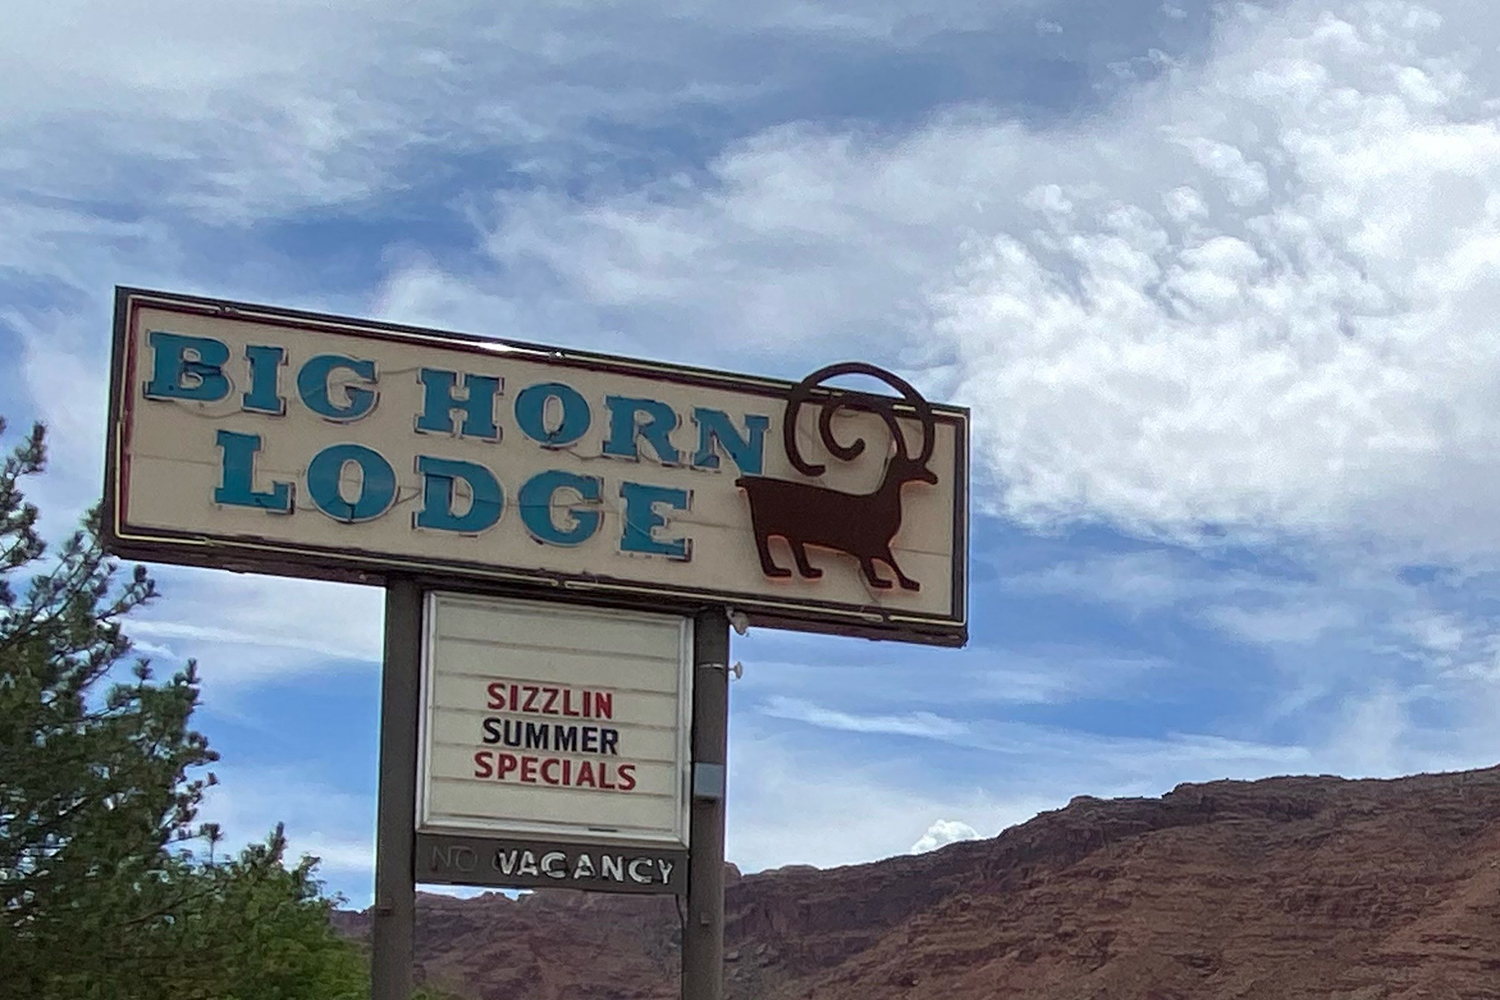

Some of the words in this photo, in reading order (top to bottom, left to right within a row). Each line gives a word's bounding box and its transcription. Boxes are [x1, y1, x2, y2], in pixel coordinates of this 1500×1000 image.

[144, 331, 381, 423] BIG
[415, 367, 771, 476] HORN
[213, 429, 694, 562] LODGE
[486, 682, 614, 719] SIZZLIN
[482, 717, 620, 755] SUMMER
[473, 751, 637, 791] SPECIALS
[498, 849, 674, 885] VACANCY
